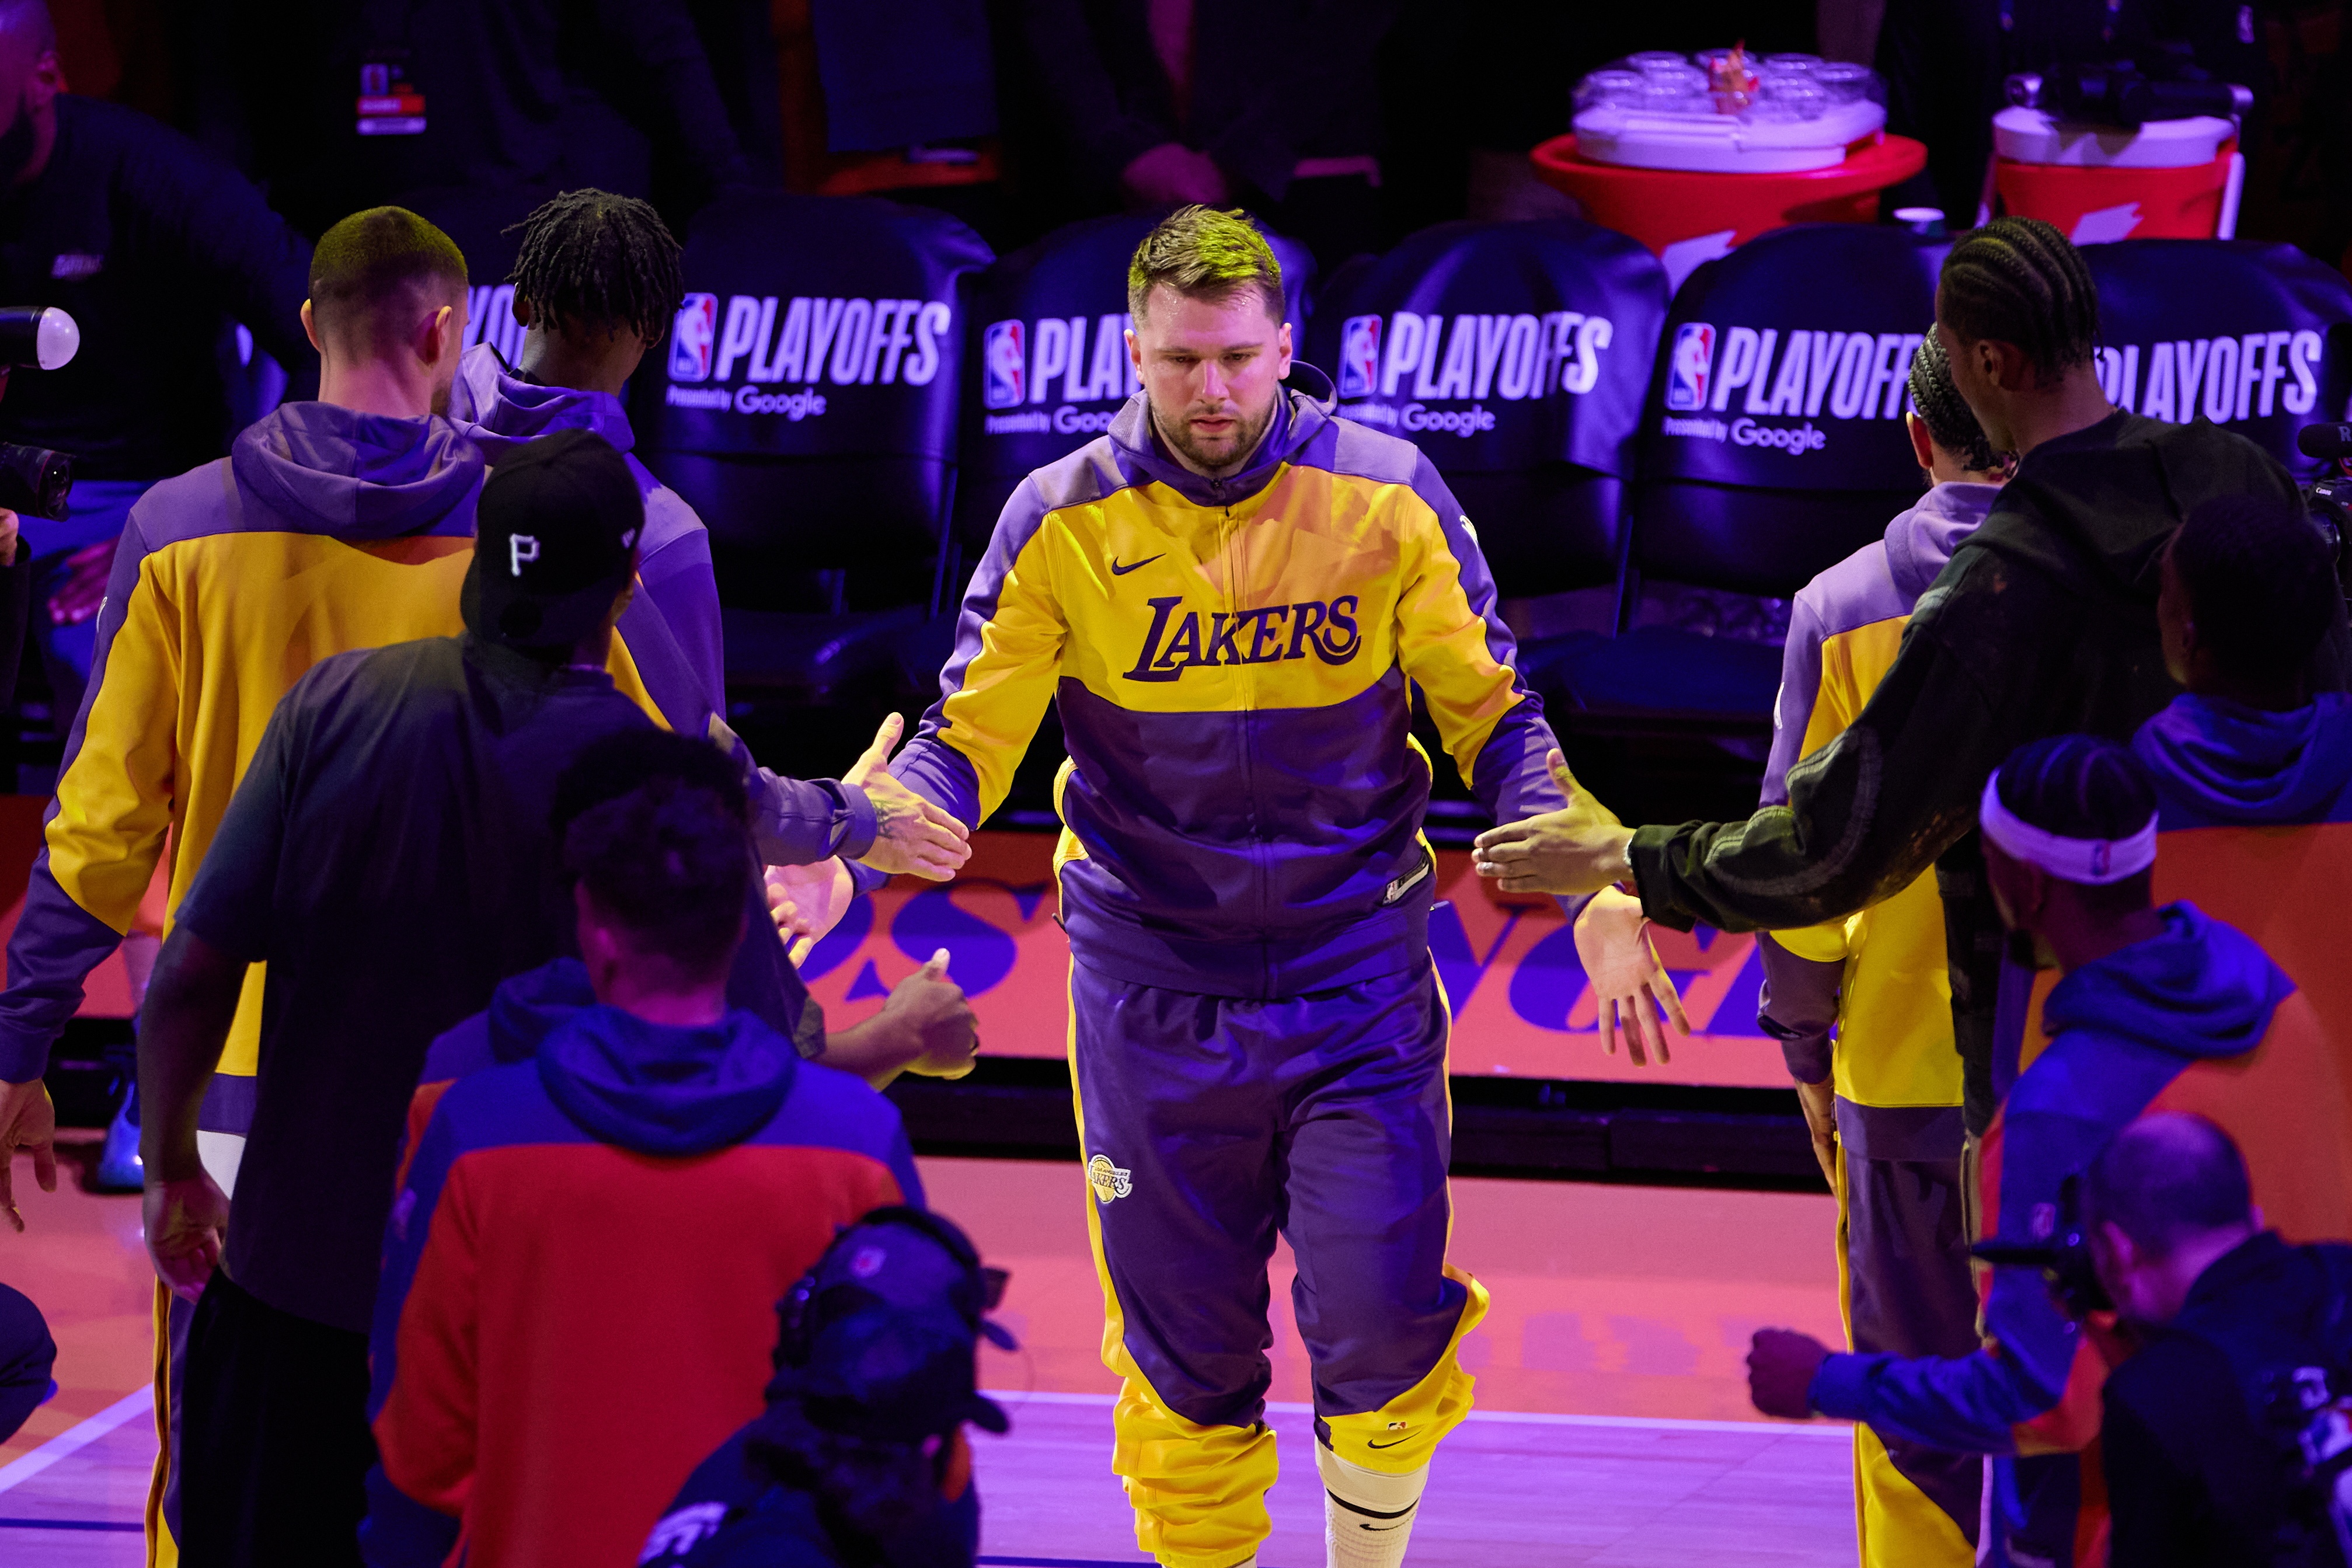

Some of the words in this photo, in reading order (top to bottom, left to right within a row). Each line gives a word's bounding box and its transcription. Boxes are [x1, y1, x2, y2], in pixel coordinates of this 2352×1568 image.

[713, 295, 951, 386] PLAYOFFS
[1379, 311, 1614, 400] PLAYOFFS
[1709, 326, 1925, 420] PLAYOFF
[734, 385, 827, 421] Google
[1402, 403, 1496, 438] Google
[1730, 417, 1827, 456] Google
[509, 533, 541, 577] P
[1122, 595, 1361, 682] LAKERS
